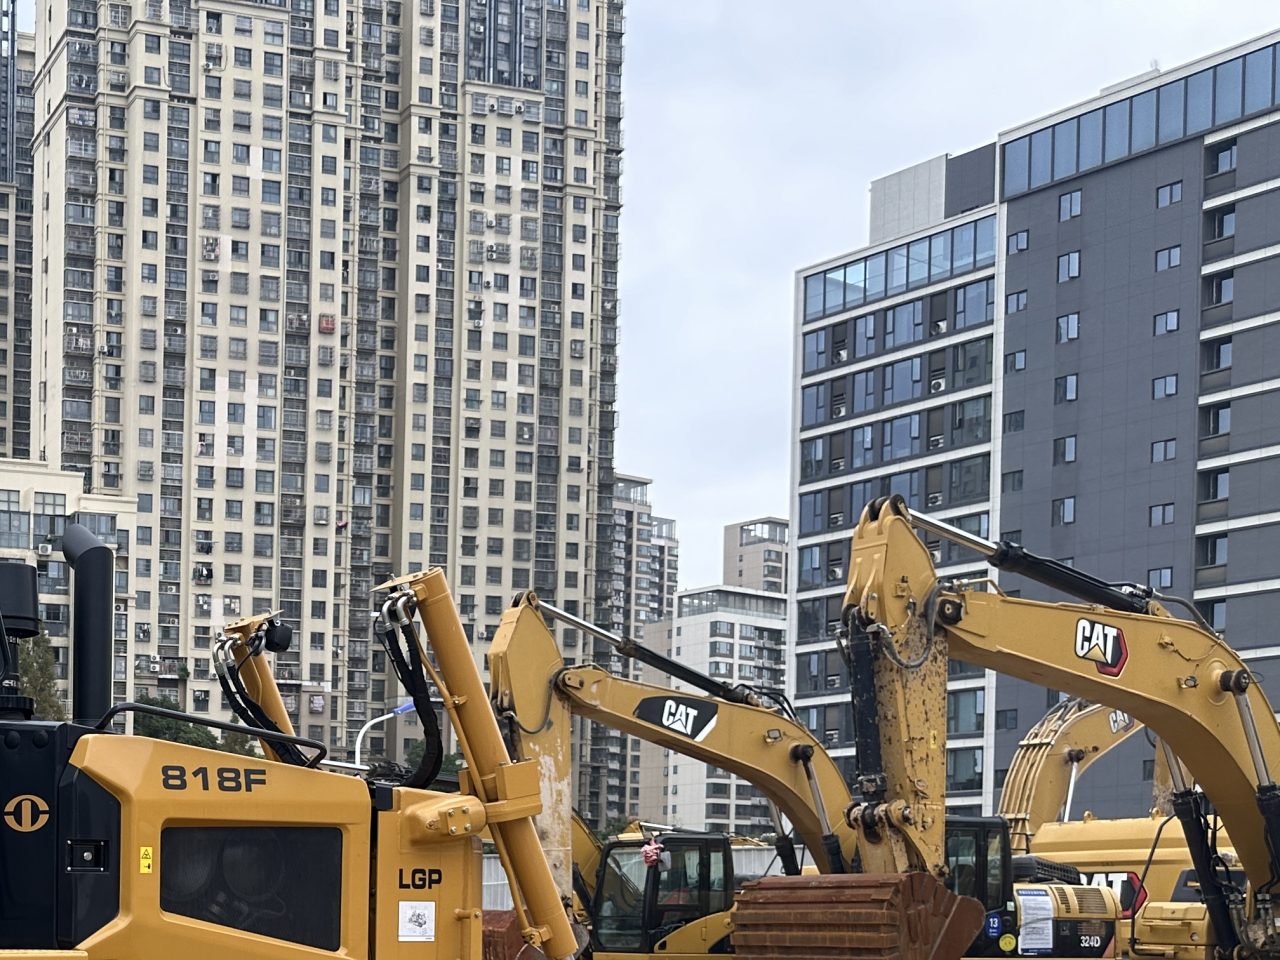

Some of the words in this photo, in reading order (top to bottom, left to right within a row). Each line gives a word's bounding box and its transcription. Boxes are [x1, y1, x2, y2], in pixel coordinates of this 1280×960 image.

[1076, 619, 1118, 664] CAT
[662, 699, 699, 735] CAT
[161, 765, 267, 793] 818F
[398, 868, 443, 890] LGP
[989, 917, 999, 928] 13
[1080, 936, 1101, 948] 324D
